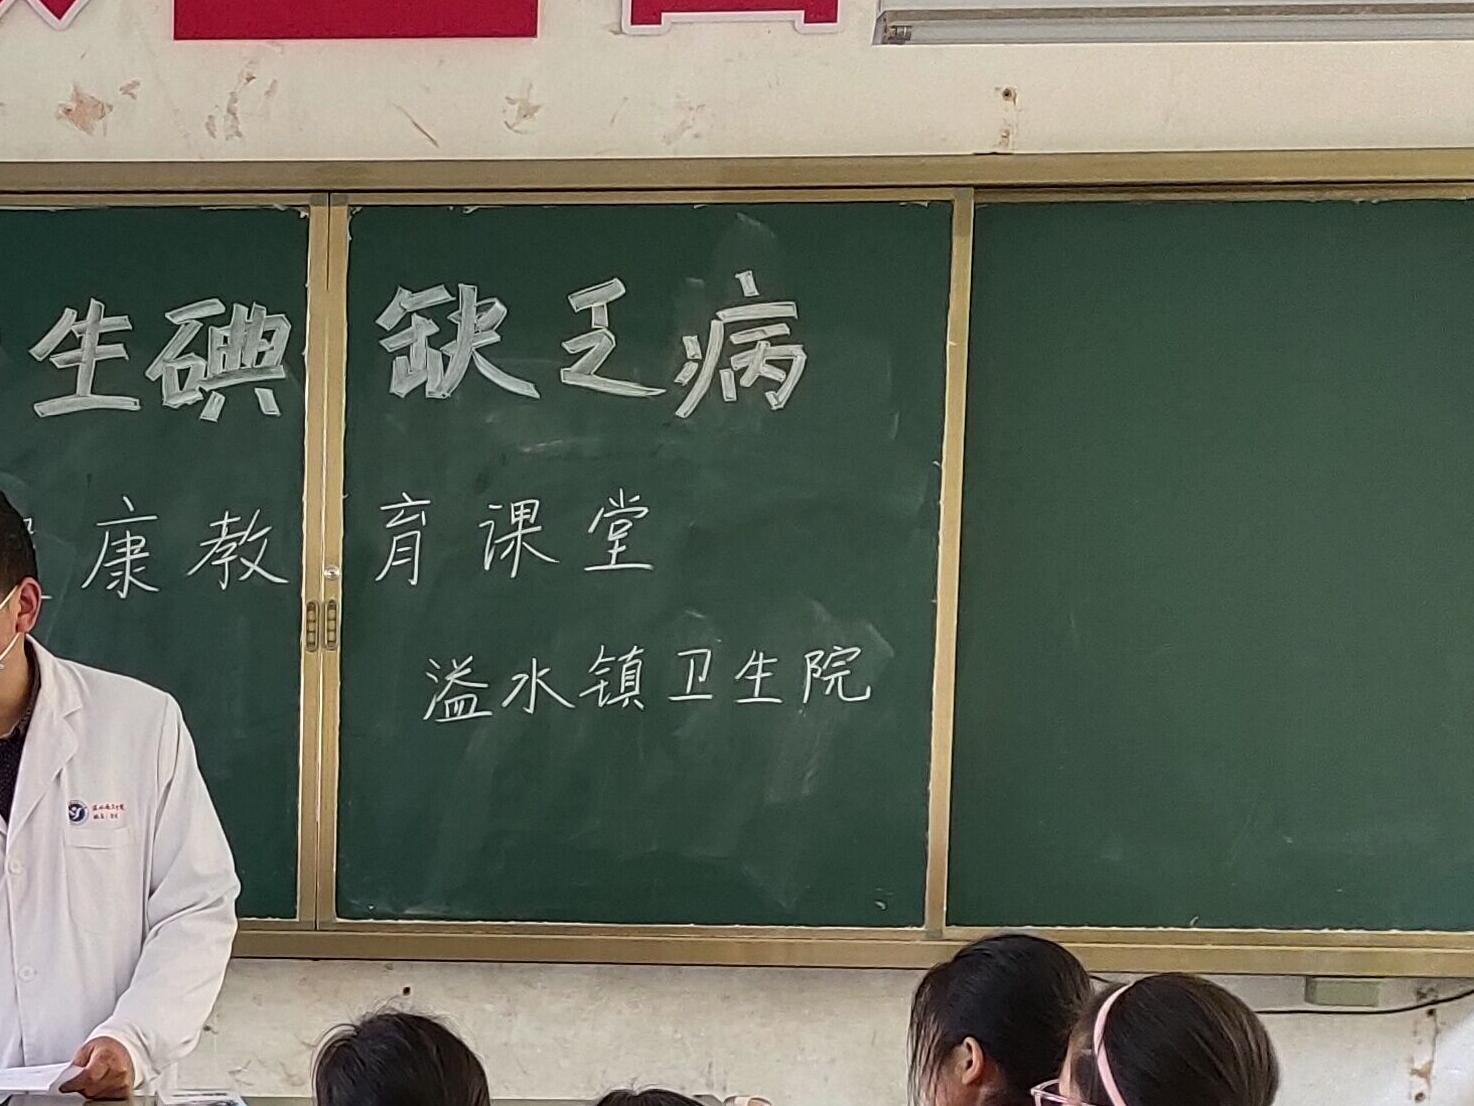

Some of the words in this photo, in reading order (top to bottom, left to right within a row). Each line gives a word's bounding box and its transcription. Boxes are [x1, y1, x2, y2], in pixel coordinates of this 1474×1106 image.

[24, 490, 655, 600] 康教育课堂
[422, 644, 872, 723] 溢水镇卫生院
